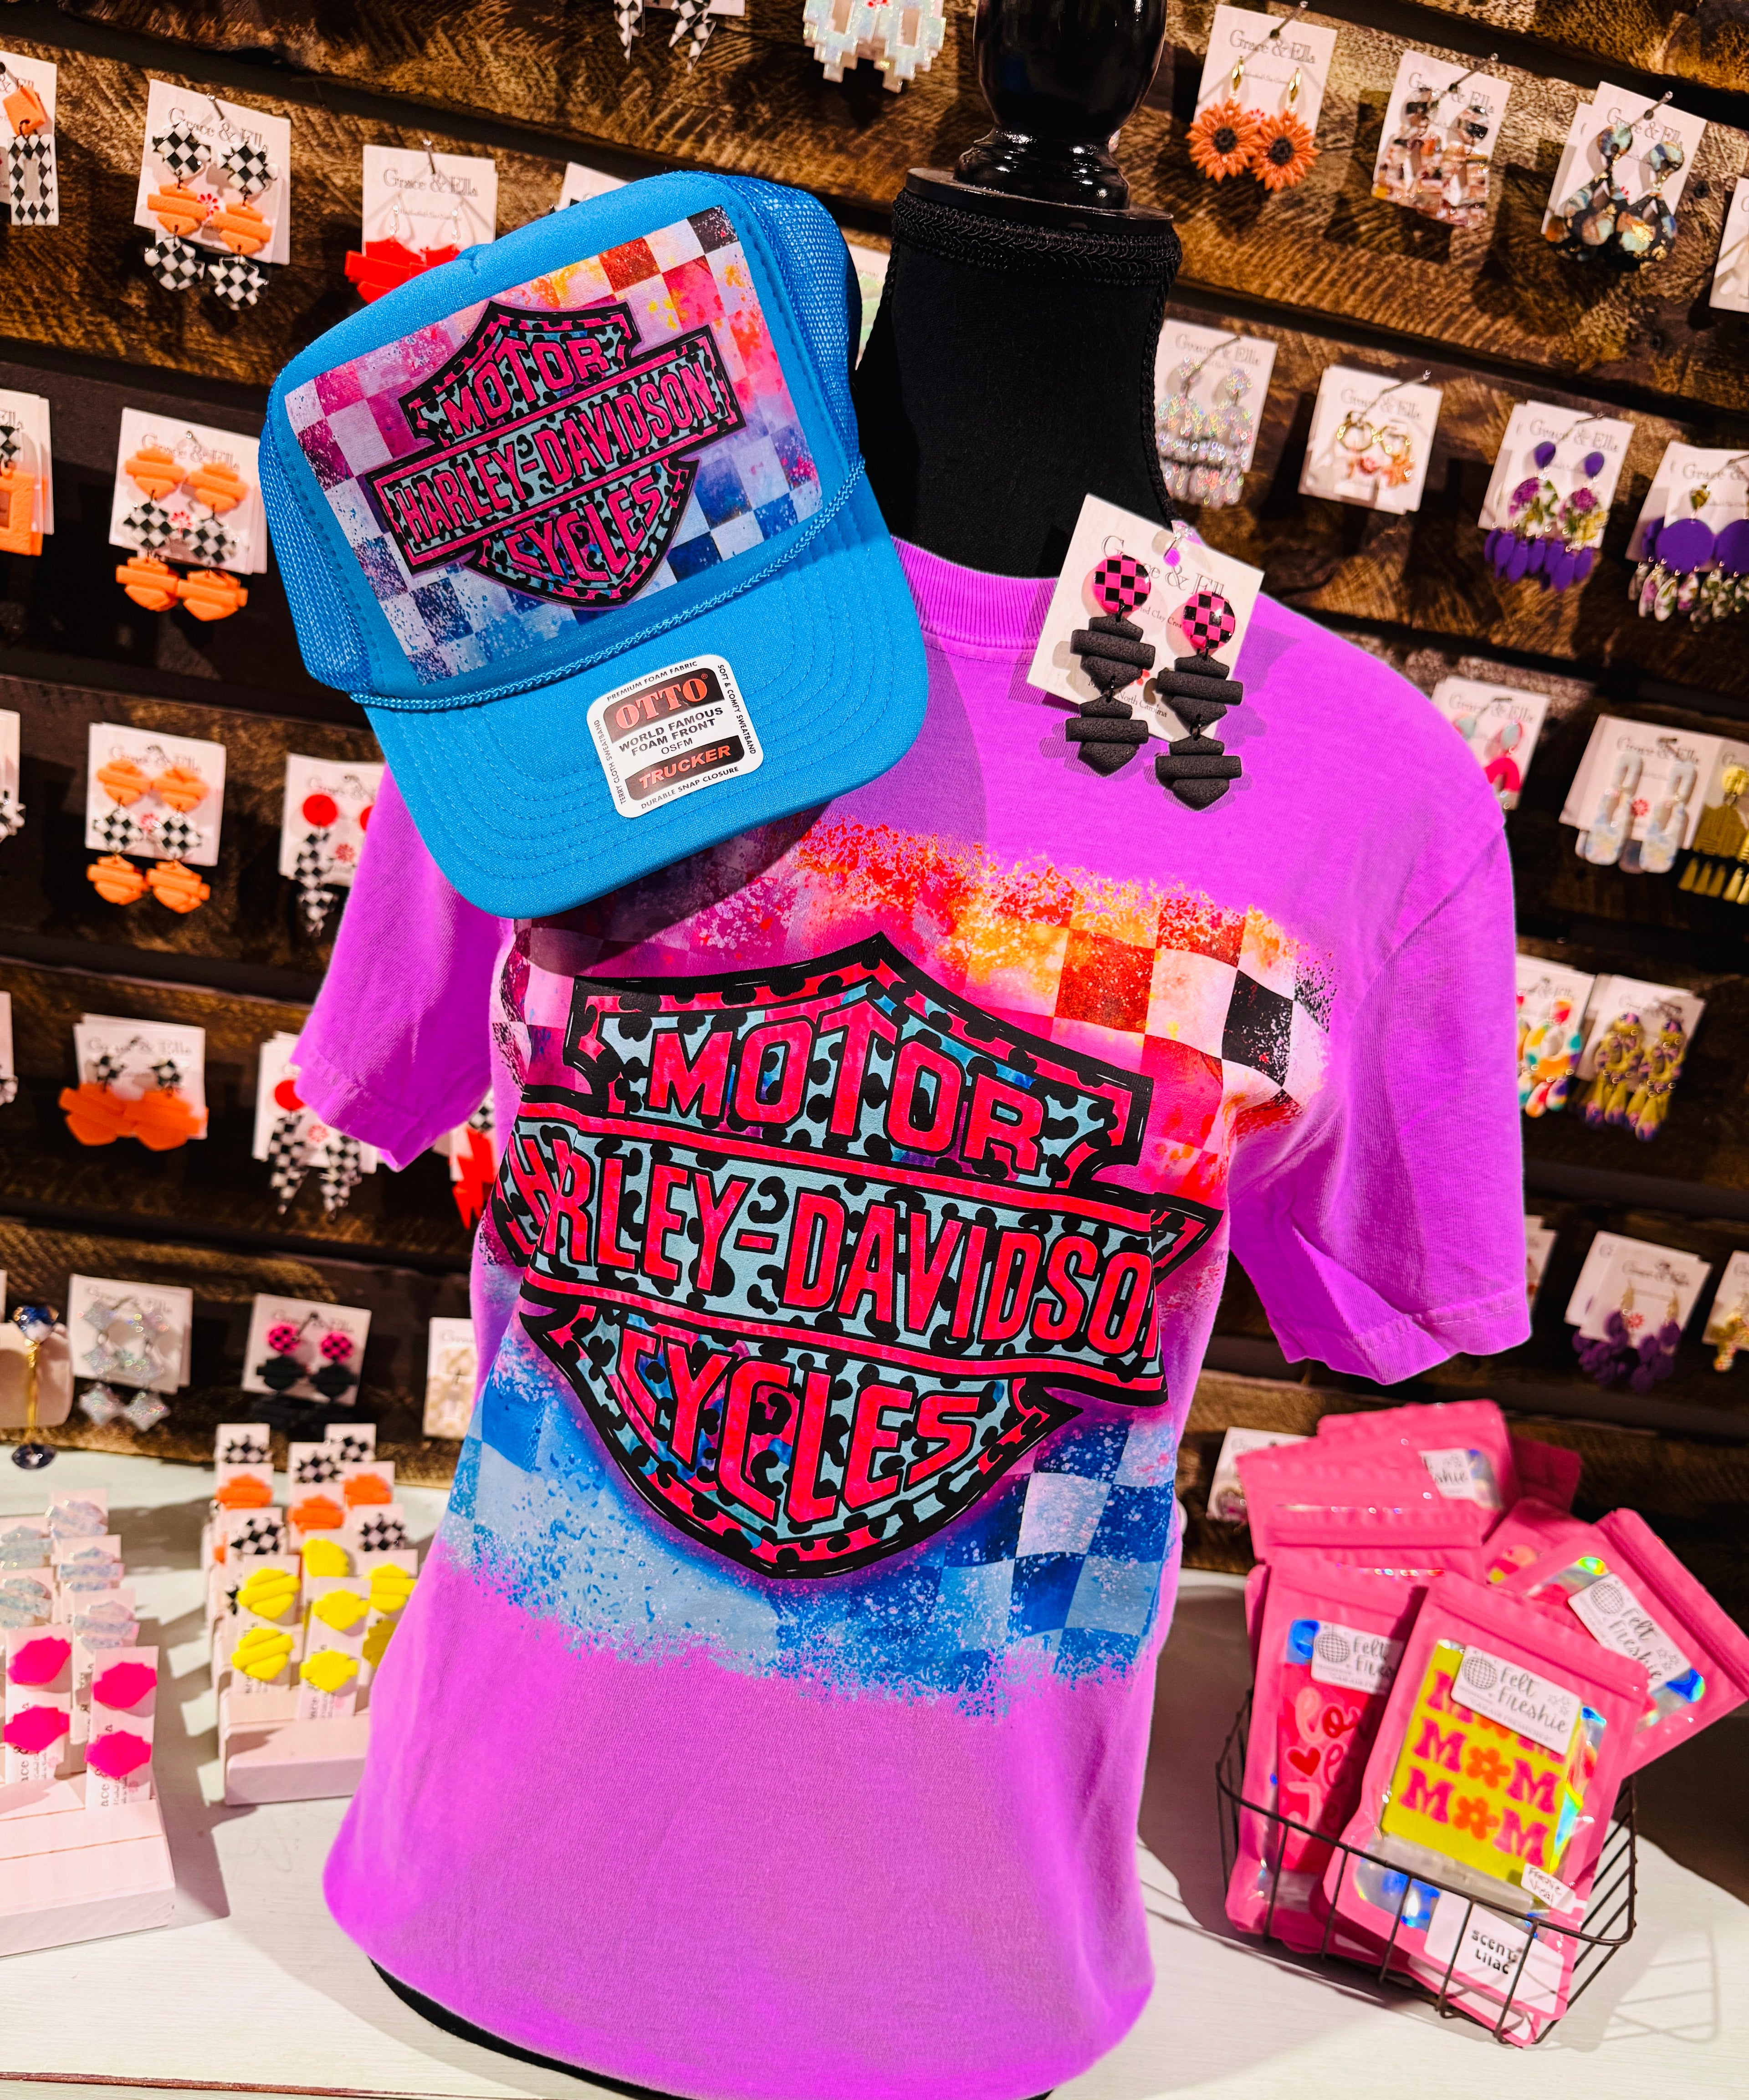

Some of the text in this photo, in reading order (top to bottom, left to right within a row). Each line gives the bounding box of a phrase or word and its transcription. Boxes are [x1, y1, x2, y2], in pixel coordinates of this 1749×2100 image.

[1272, 38, 1288, 58] &
[219, 122, 236, 143] &
[1645, 121, 1659, 140] &
[430, 174, 445, 194] &
[443, 337, 609, 436] MOTOR
[395, 361, 717, 544] HARLEY-DAVIDSON
[503, 469, 666, 583] CYCLES
[1165, 564, 1189, 591] &
[1191, 572, 1230, 603] Ell
[1152, 609, 1166, 623] Clay
[607, 661, 698, 702] PREMIUM FOAM FABRIC
[615, 678, 708, 730] OTTO
[718, 664, 729, 681] SOFT
[727, 689, 742, 713] COMFY
[736, 714, 756, 755] SWEATBAND
[1117, 690, 1167, 718] North Carolina
[619, 707, 723, 753] WORLD FAMOUS
[631, 718, 716, 757] FOAM FRONT
[661, 738, 693, 755] OSFM
[593, 720, 627, 805] TERRY CLOTH SWEATBAND
[639, 745, 731, 791] TRUCKER
[641, 766, 740, 809] DURABLE SNAP CLOSURE
[647, 998, 1049, 1173] MOTOR
[617, 1323, 980, 1523] CYCLES
[1621, 1608, 1659, 1641] Felt
[1500, 1666, 1542, 1698] Felt
[1498, 1686, 1568, 1732] Freshie
